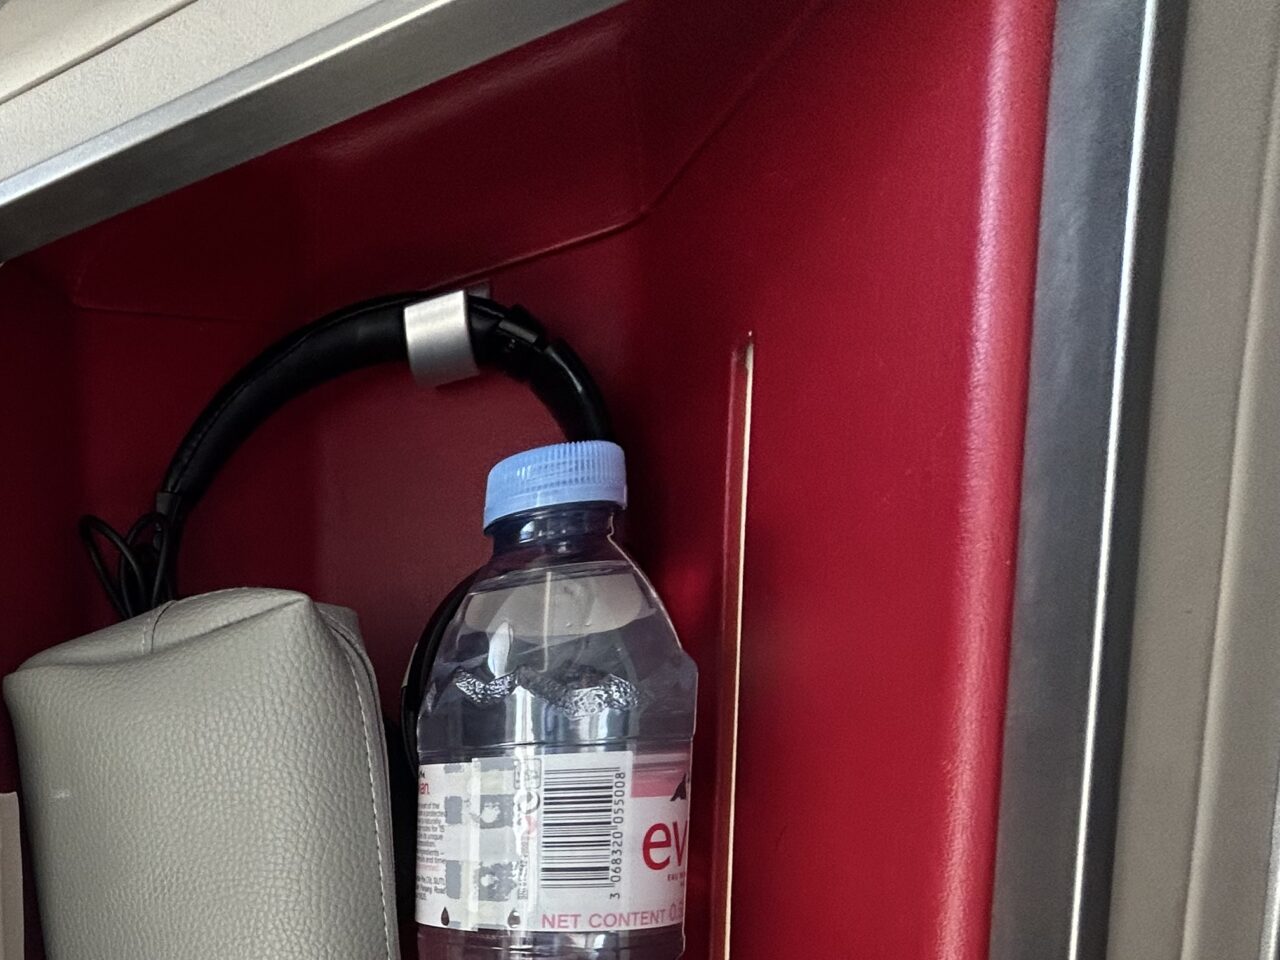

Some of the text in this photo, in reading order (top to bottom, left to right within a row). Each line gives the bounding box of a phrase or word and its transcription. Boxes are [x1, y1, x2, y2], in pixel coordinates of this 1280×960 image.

[609, 772, 626, 900] 3 068320 055008
[541, 912, 581, 930] NET
[588, 908, 666, 929] CONTENT
